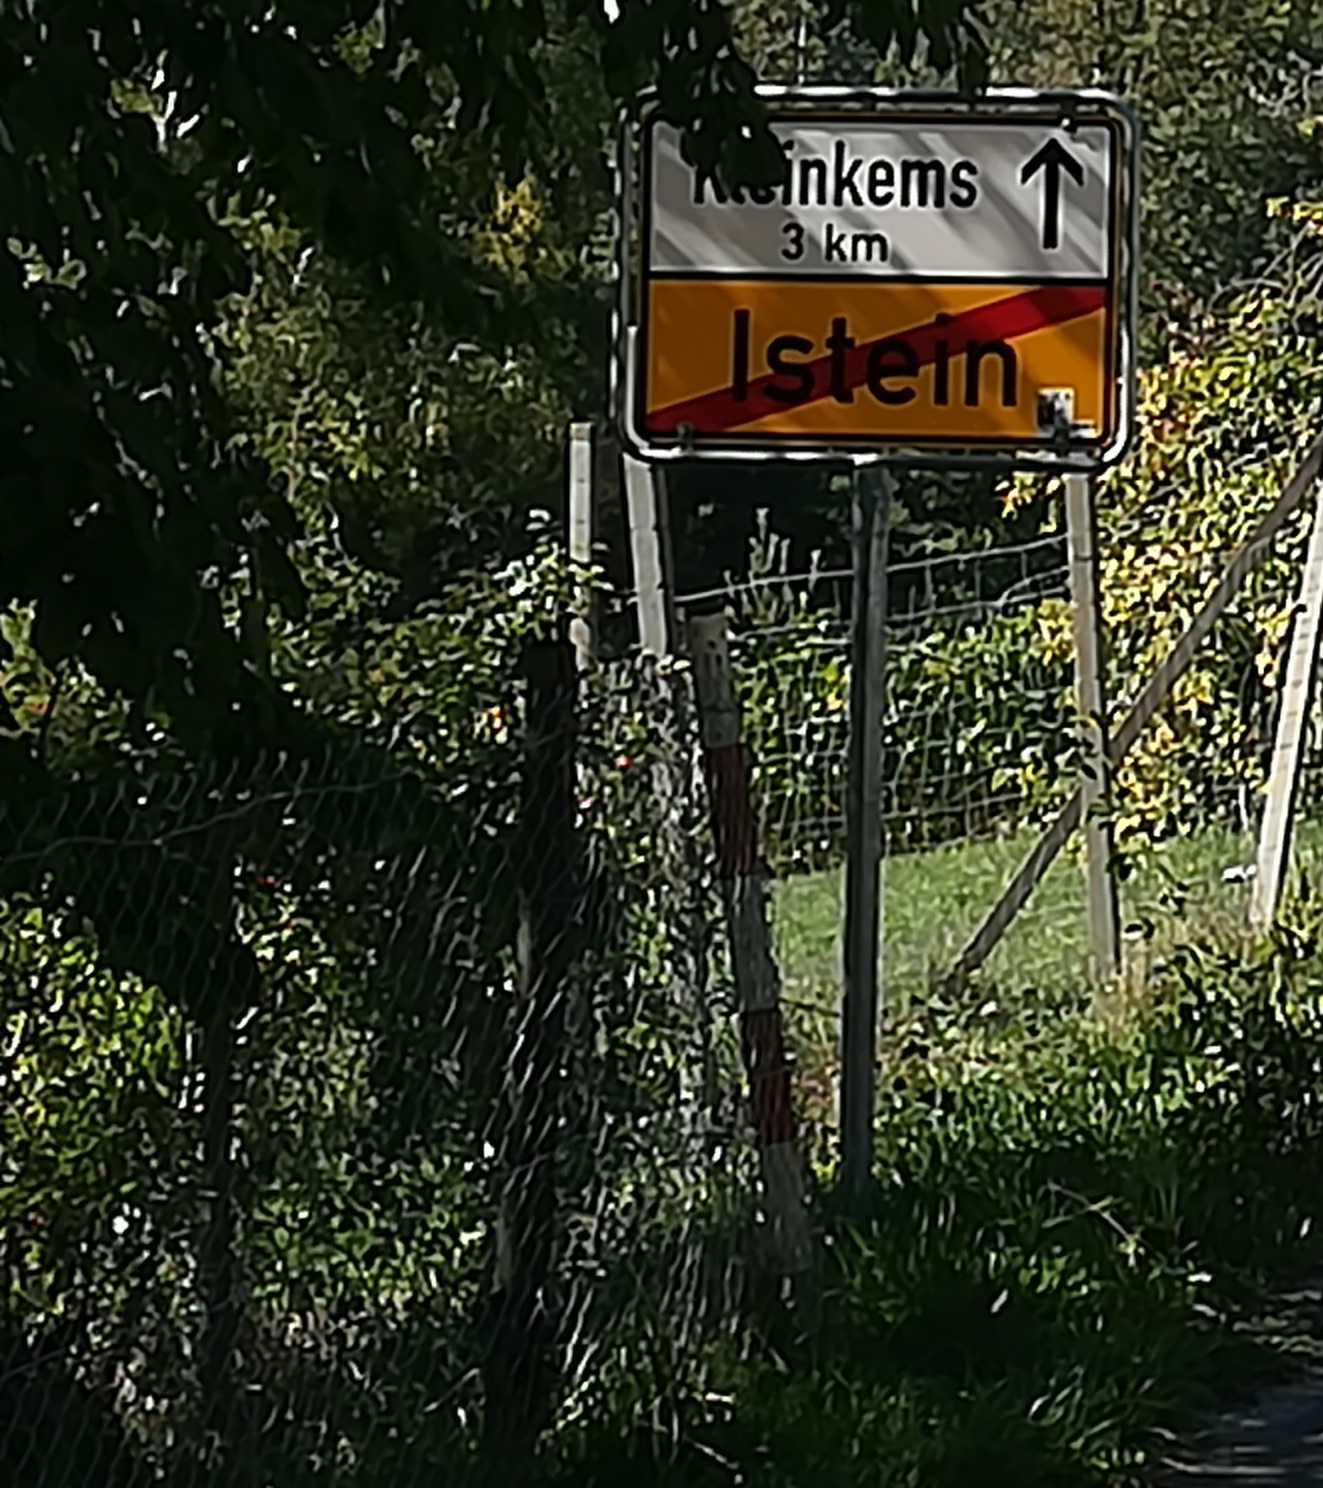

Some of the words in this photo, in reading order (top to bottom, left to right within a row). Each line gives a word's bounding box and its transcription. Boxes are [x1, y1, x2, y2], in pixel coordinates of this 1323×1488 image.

[693, 140, 978, 208] Kinkems
[781, 222, 804, 260] 3
[825, 223, 889, 262] km
[732, 309, 1018, 408] Istein
